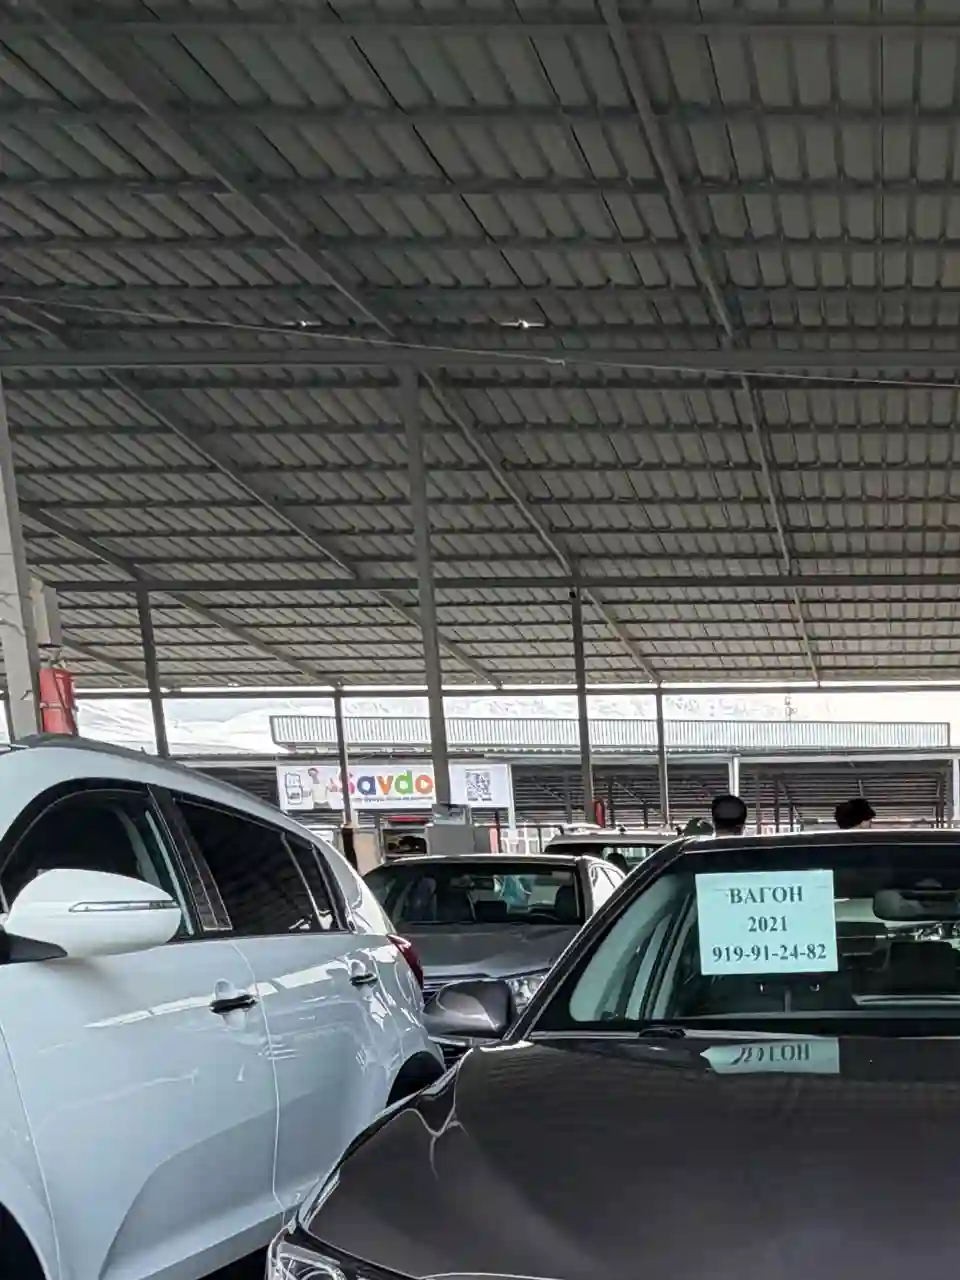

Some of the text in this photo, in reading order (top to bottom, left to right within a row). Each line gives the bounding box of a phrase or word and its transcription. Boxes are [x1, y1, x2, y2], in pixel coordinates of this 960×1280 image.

[728, 885, 803, 904] ВАГОН
[747, 915, 788, 933] 2021
[712, 943, 827, 962] 919-91-24-82
